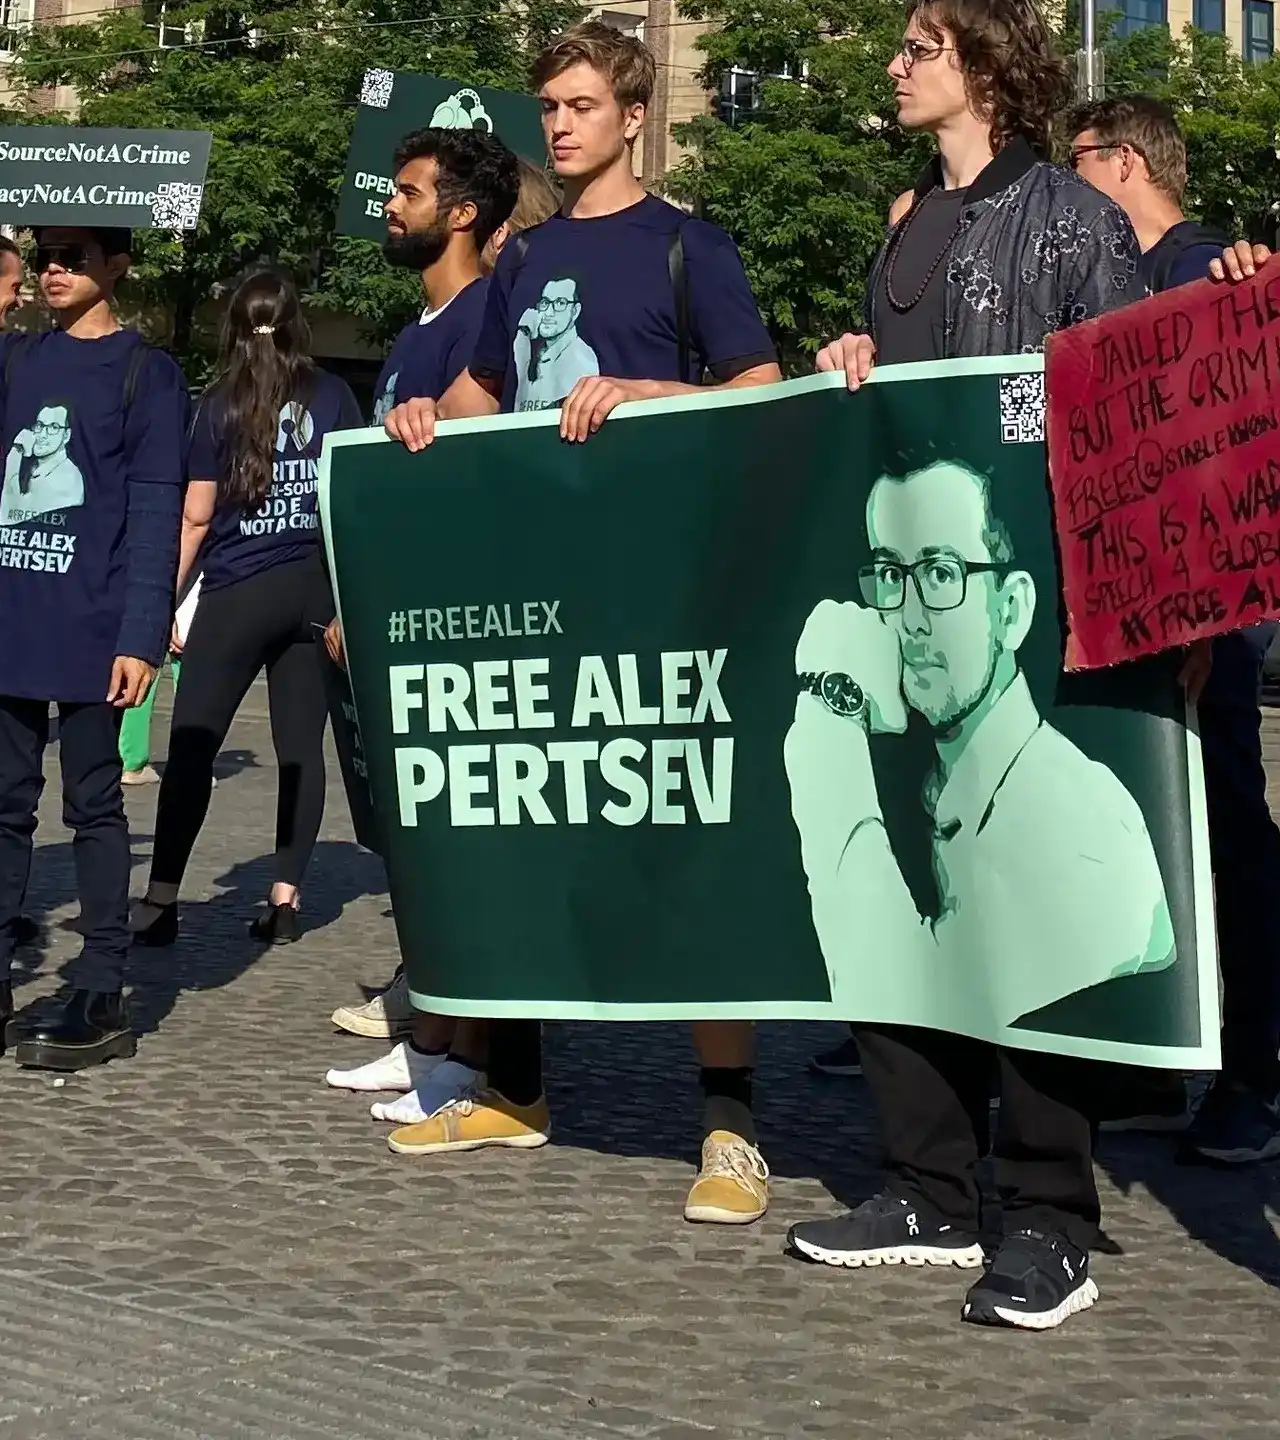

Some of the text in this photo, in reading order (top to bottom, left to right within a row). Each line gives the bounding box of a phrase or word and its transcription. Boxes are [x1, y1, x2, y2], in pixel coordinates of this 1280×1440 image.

[1092, 310, 1193, 384] JAILED
[1121, 372, 1179, 434] THE
[28, 531, 77, 553] ALEX
[240, 518, 275, 536] NOT
[276, 517, 287, 534] A
[1077, 521, 1148, 576] THIS
[1158, 499, 1187, 556] IS
[1199, 493, 1220, 536] A
[388, 600, 564, 643] #FREEALEX
[388, 648, 733, 734] FREE ALEX
[394, 737, 735, 828] PERTSEV
